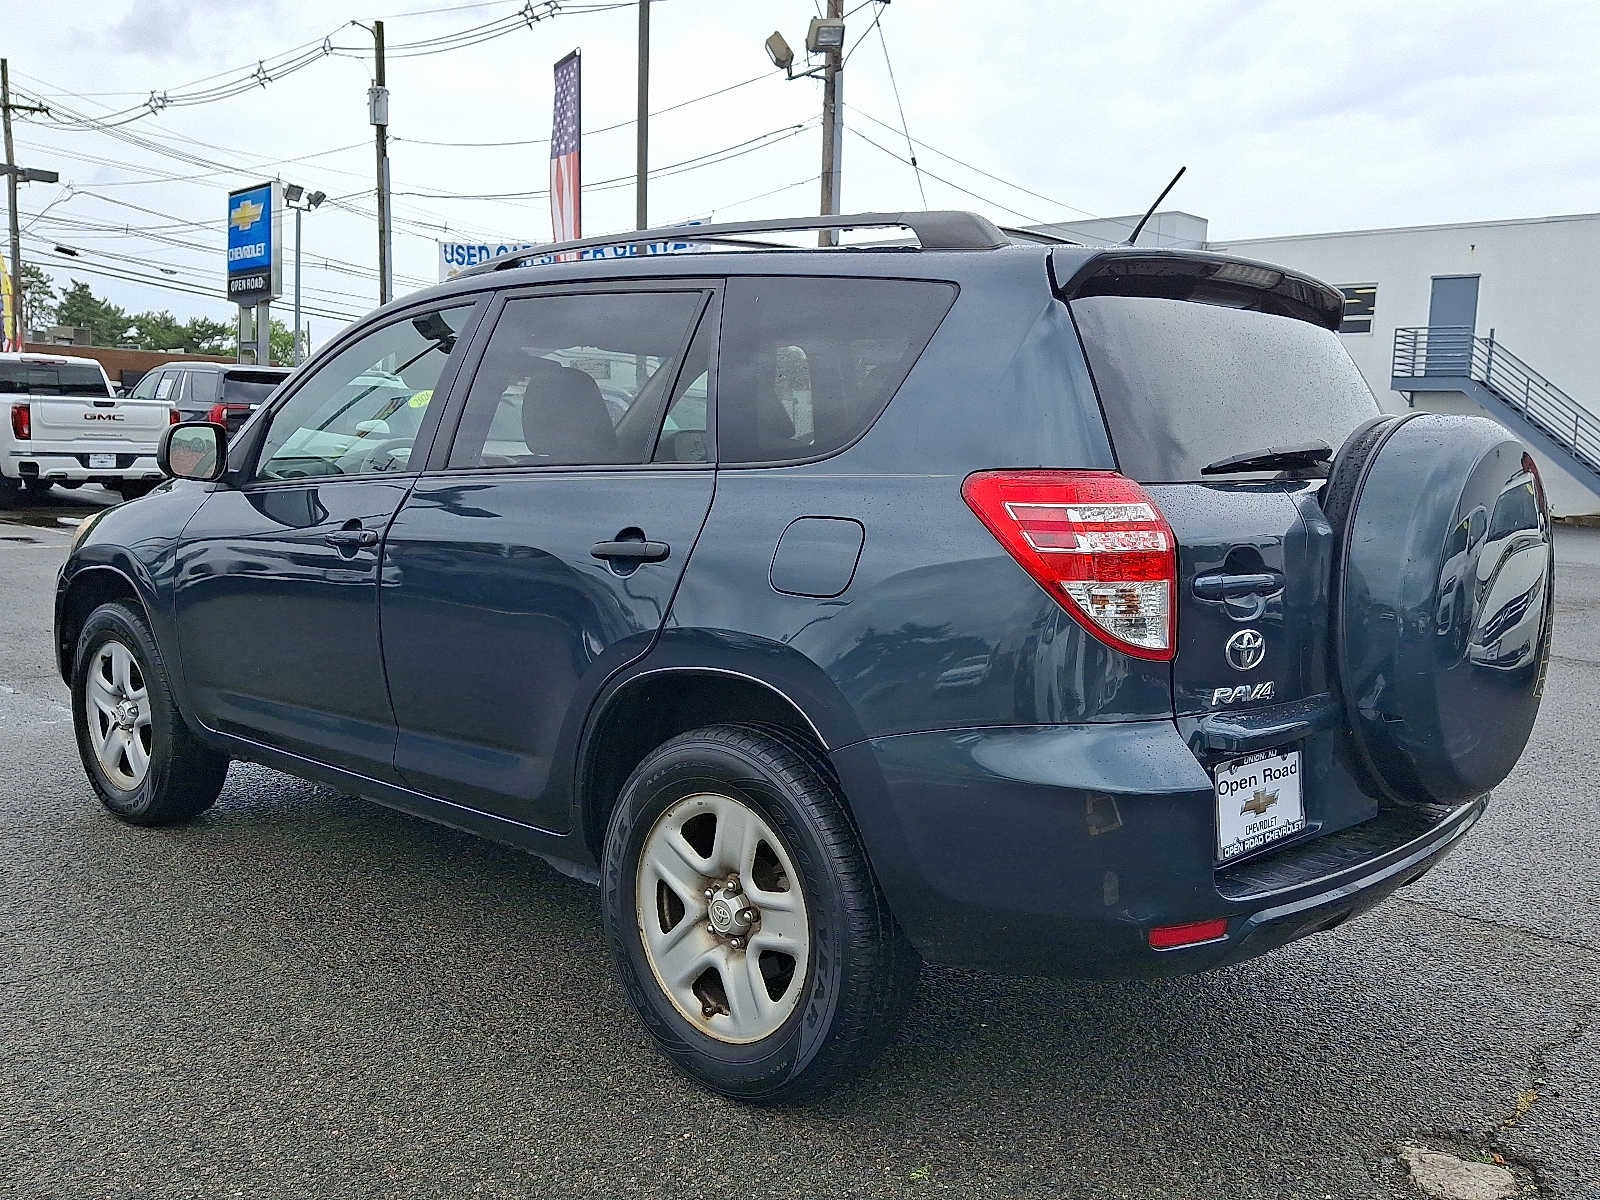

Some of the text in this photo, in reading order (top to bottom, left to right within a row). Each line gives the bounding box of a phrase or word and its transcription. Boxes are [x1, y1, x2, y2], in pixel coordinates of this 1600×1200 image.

[229, 243, 266, 261] CHEVROLET
[444, 243, 490, 266] USED
[230, 276, 264, 293] OPEN ROAD
[84, 413, 125, 422] GMC
[1211, 681, 1275, 706] RAV4
[1218, 760, 1297, 796] Open Road
[1245, 816, 1278, 836] CHEVROLET
[1224, 822, 1304, 858] OPEN ROAD CHEVROLET
